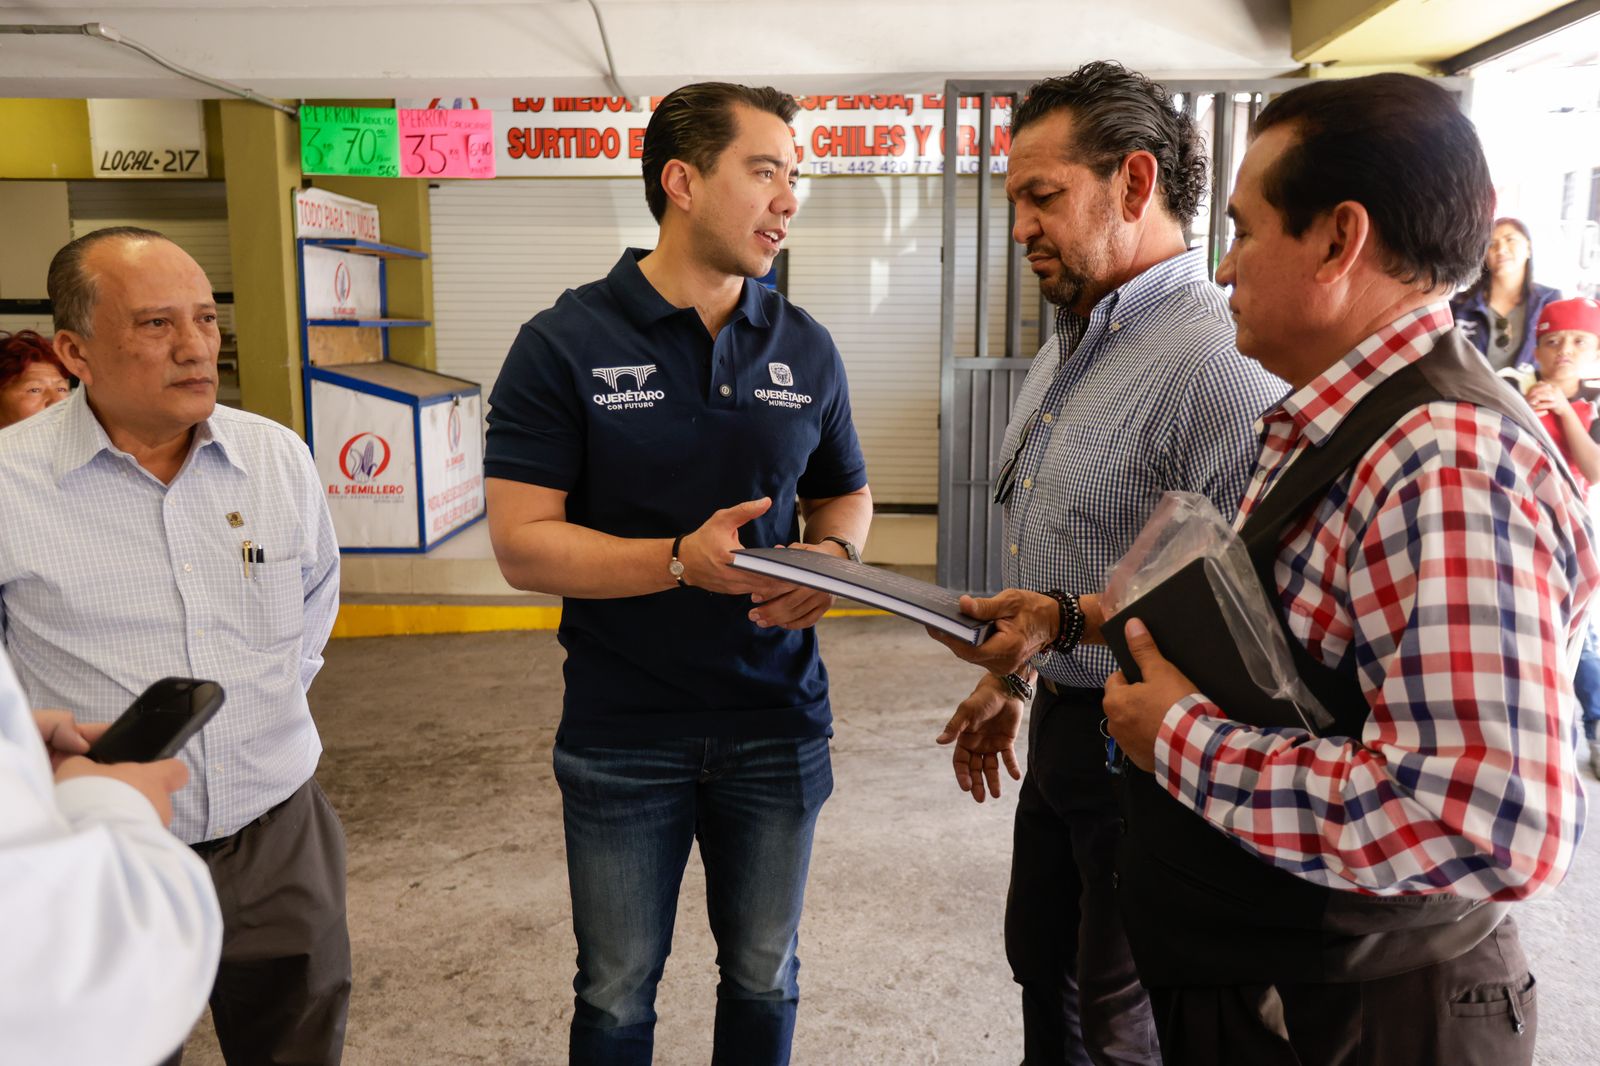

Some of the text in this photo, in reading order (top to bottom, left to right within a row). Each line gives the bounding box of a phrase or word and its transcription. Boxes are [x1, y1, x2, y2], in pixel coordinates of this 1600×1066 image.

[342, 127, 377, 165] 70
[507, 126, 621, 159] SURTIDO
[811, 124, 906, 158] CHILES
[912, 124, 933, 157] Y
[163, 149, 200, 172] 217
[404, 133, 447, 175] 35
[810, 161, 843, 174] TEL:
[847, 160, 875, 174] 442
[880, 160, 908, 174] 420
[298, 199, 322, 229] TODO
[324, 205, 345, 232] PARA
[346, 210, 357, 236] TU
[593, 389, 665, 405] QUERÉTARO
[624, 401, 654, 410] FUTURO
[754, 389, 812, 404] QUERÉTARO
[768, 399, 802, 410] MUNICIPIO
[328, 484, 405, 495] EL SEMILLERO
